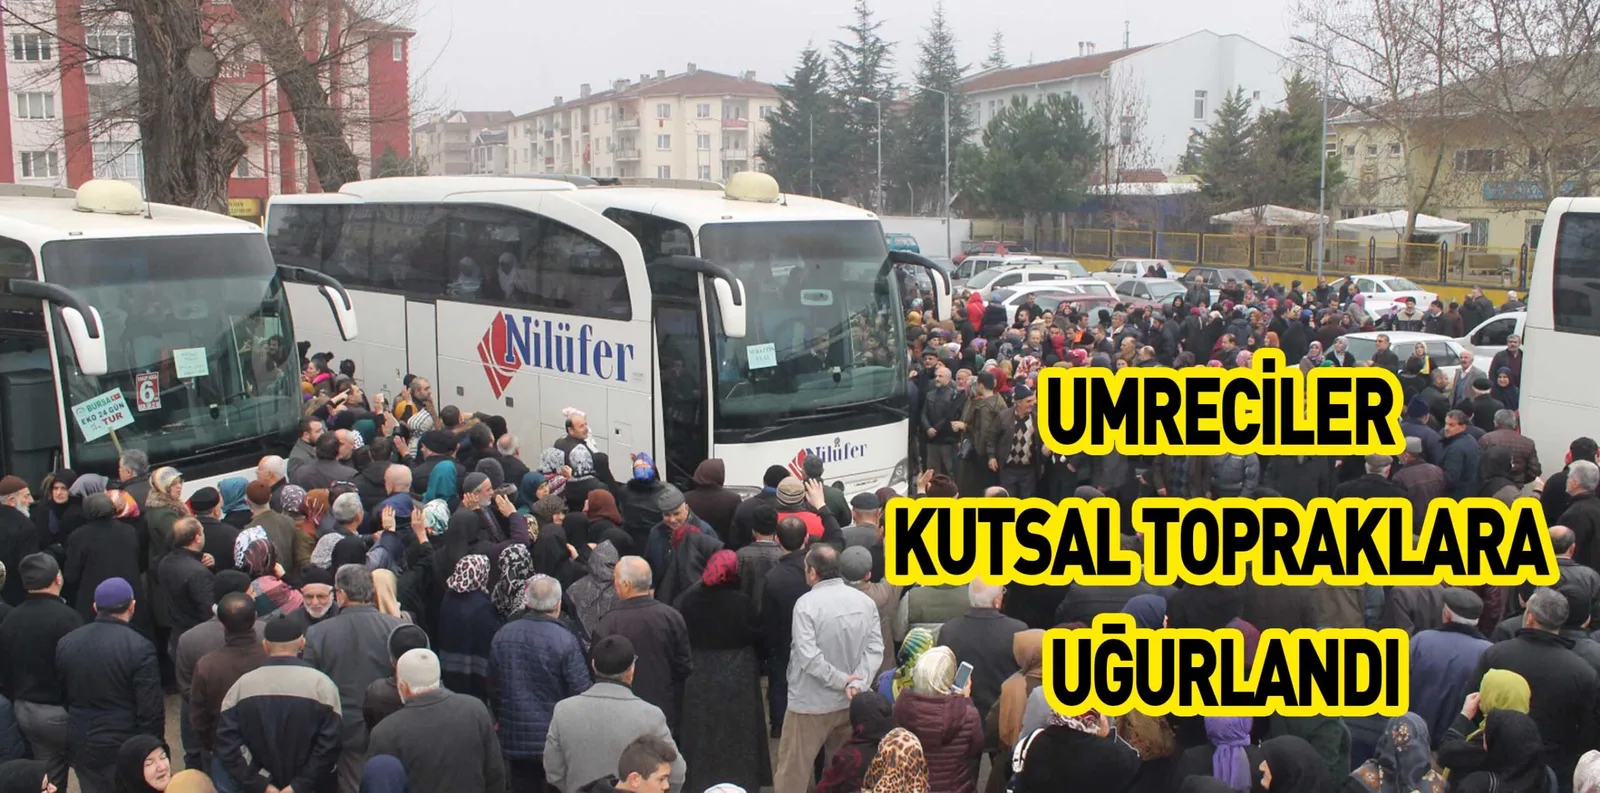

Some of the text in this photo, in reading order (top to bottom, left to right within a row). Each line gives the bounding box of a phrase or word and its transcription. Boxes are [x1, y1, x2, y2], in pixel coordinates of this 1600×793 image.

[504, 313, 634, 382] Nilüfer
[140, 380, 155, 404] 6
[81, 402, 125, 425] EKO 24 GÜN
[86, 397, 112, 413] BURSA
[101, 413, 123, 425] TUR
